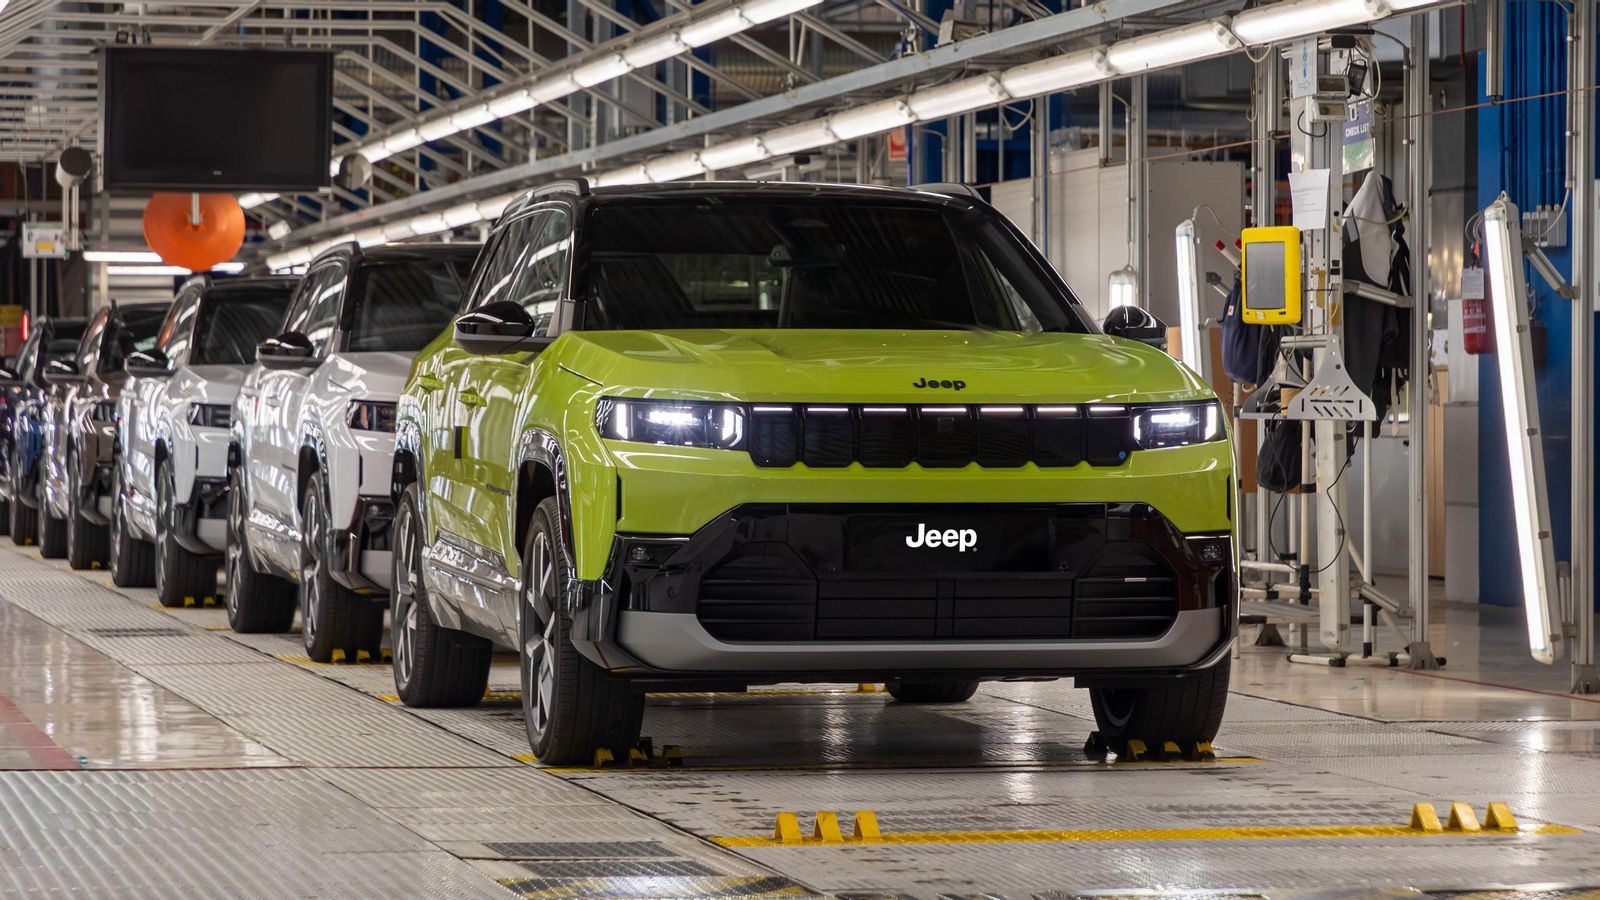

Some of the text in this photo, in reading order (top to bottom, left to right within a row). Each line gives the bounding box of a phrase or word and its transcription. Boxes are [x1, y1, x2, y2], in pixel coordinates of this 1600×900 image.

[1345, 126, 1359, 137] CHECK
[913, 377, 966, 391] Jeep
[905, 523, 978, 552] Jeep
